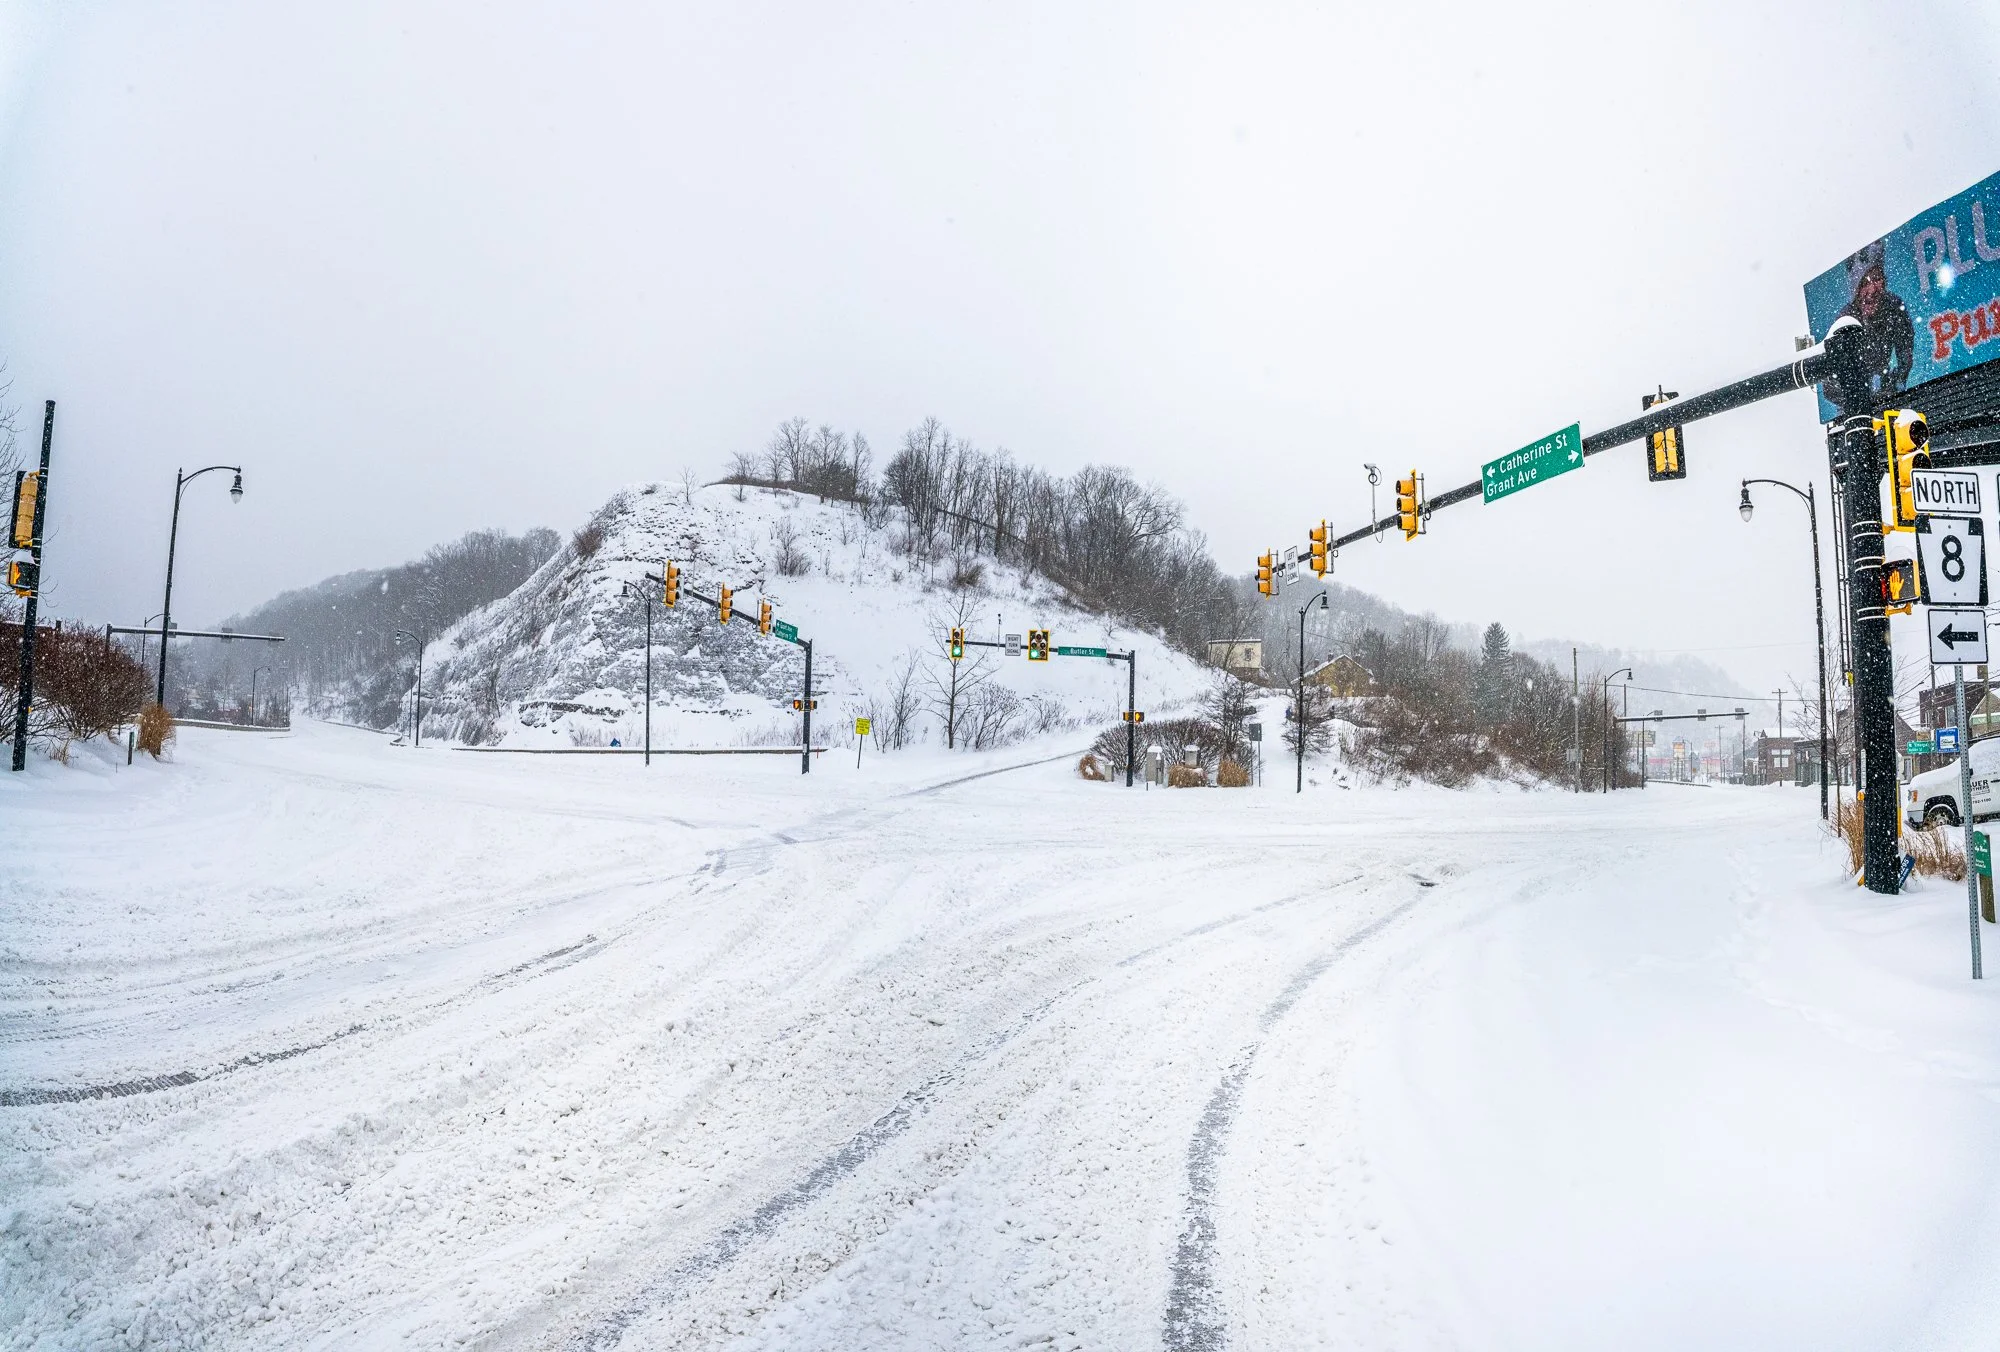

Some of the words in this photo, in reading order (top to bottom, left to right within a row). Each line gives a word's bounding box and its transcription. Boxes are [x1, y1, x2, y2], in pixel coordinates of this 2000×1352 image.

[1500, 442, 1552, 473] Catherine
[1555, 433, 1568, 450] St
[1486, 475, 1515, 497] Grant
[1517, 467, 1537, 486] Ave
[1915, 477, 1978, 505] NORTH
[1941, 534, 1966, 583] 8
